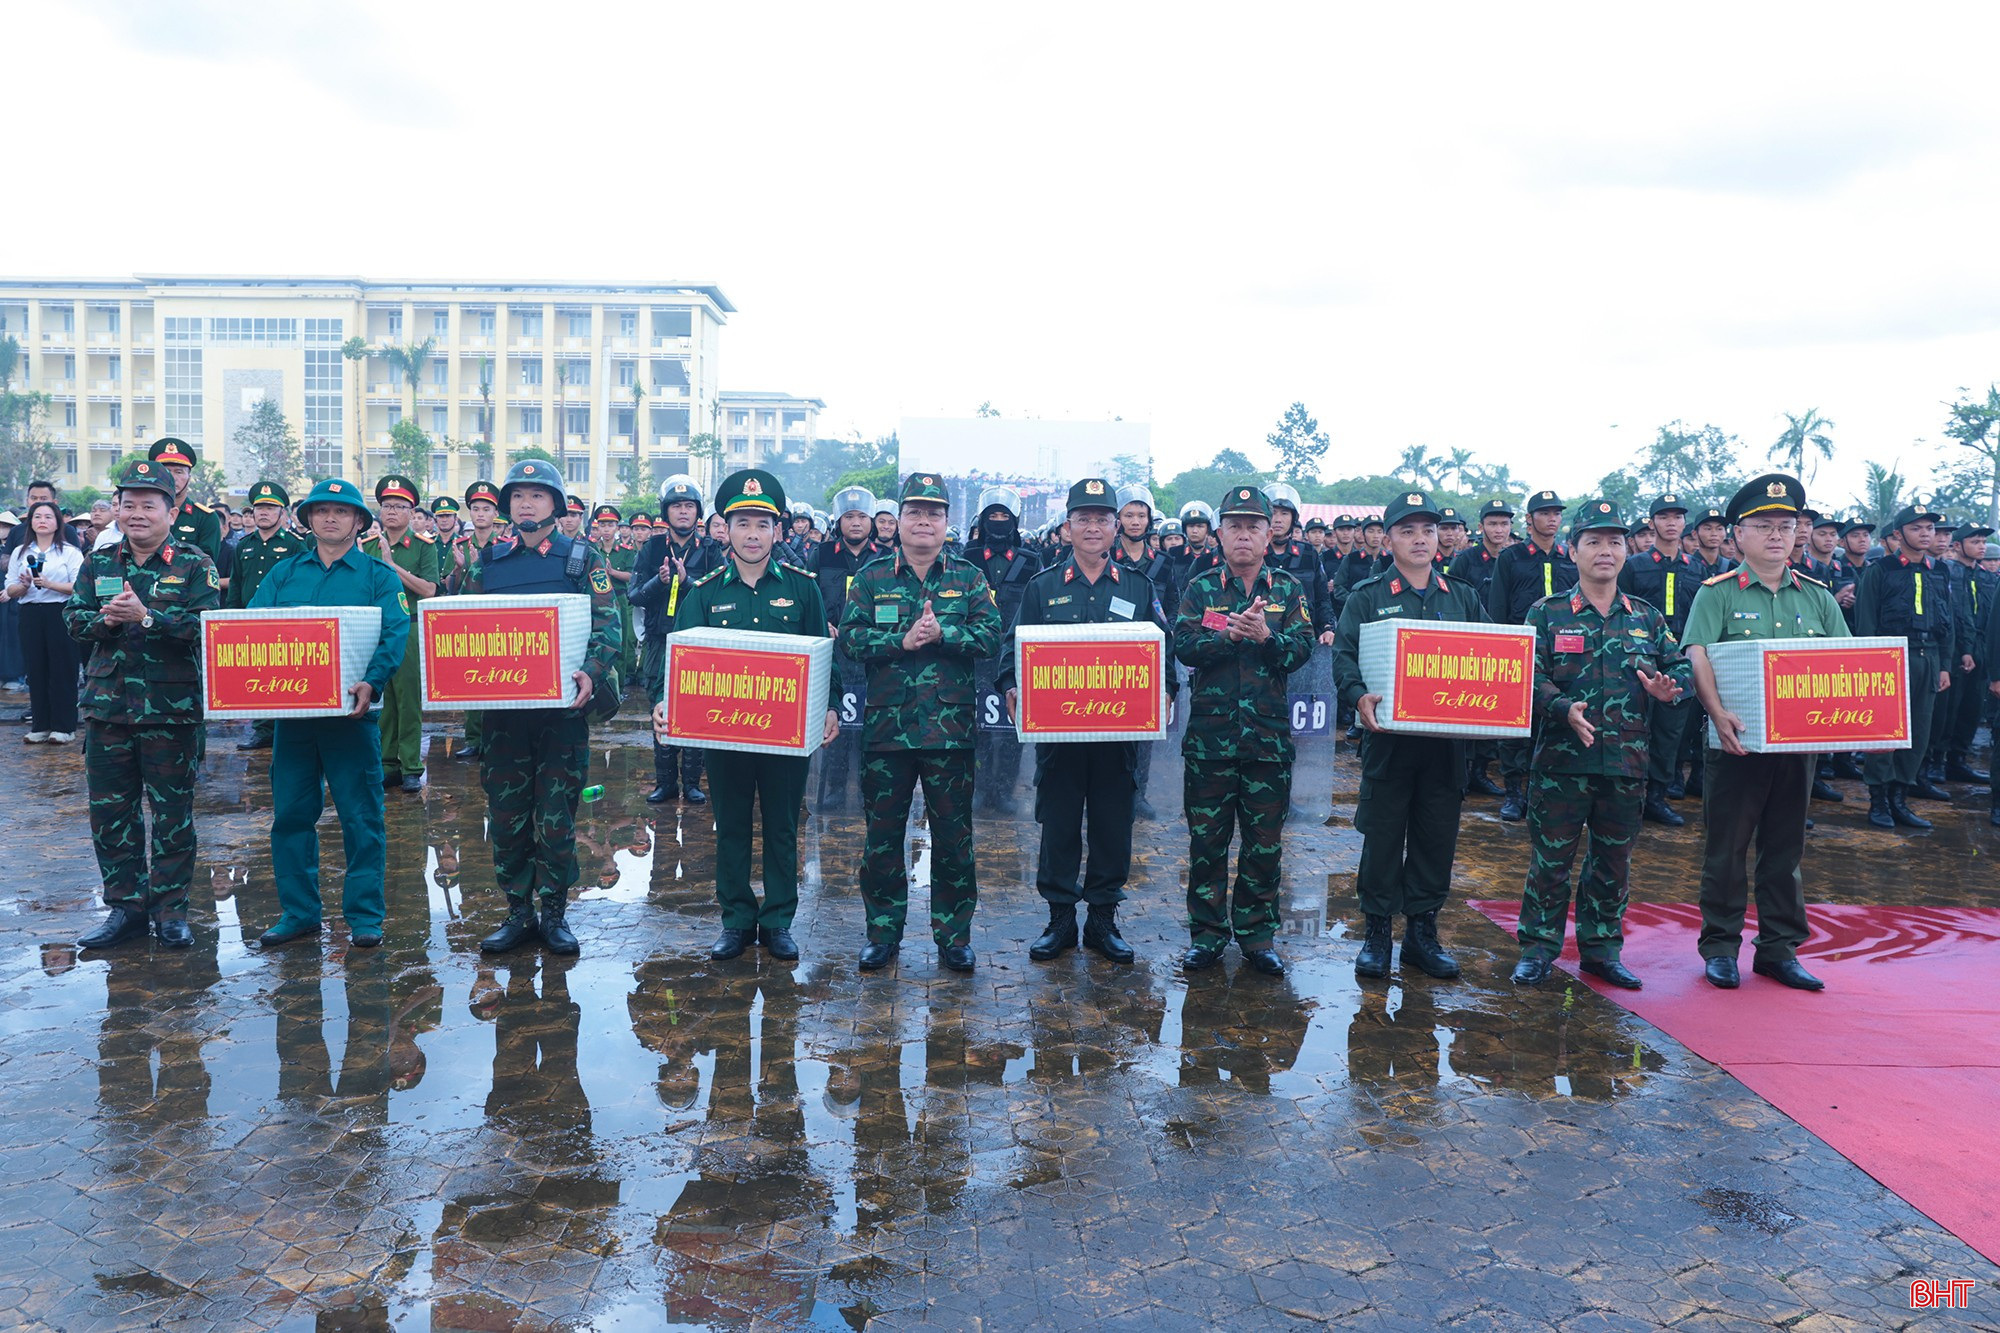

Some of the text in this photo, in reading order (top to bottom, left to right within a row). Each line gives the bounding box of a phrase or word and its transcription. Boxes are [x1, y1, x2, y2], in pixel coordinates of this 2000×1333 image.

[217, 634, 329, 672] BAN CHỈ ĐẠO DIỄN TẬP PT-26
[435, 624, 549, 662] BAN CHỈ ĐẠO DIỄN TẬP PT-26
[464, 667, 528, 686] TẶNG
[1033, 657, 1149, 694] BAN CHỈ ĐẠO DIỄN TẬP PT-26
[1407, 647, 1521, 687] BAN CHỈ ĐẠO DIỄN TẬP PT-26
[245, 676, 309, 695] TẶNG
[680, 664, 796, 705] BAN CHỈ ĐẠO DIỄN TẬP PT-26
[1776, 665, 1895, 703] BAN CHỈ ĐẠO DIỄN TẬP PT-26
[1061, 699, 1127, 718] TẶNG
[1433, 691, 1498, 711] TẶNG
[706, 709, 772, 730] TẶNG
[1806, 708, 1874, 727] TẶNG
